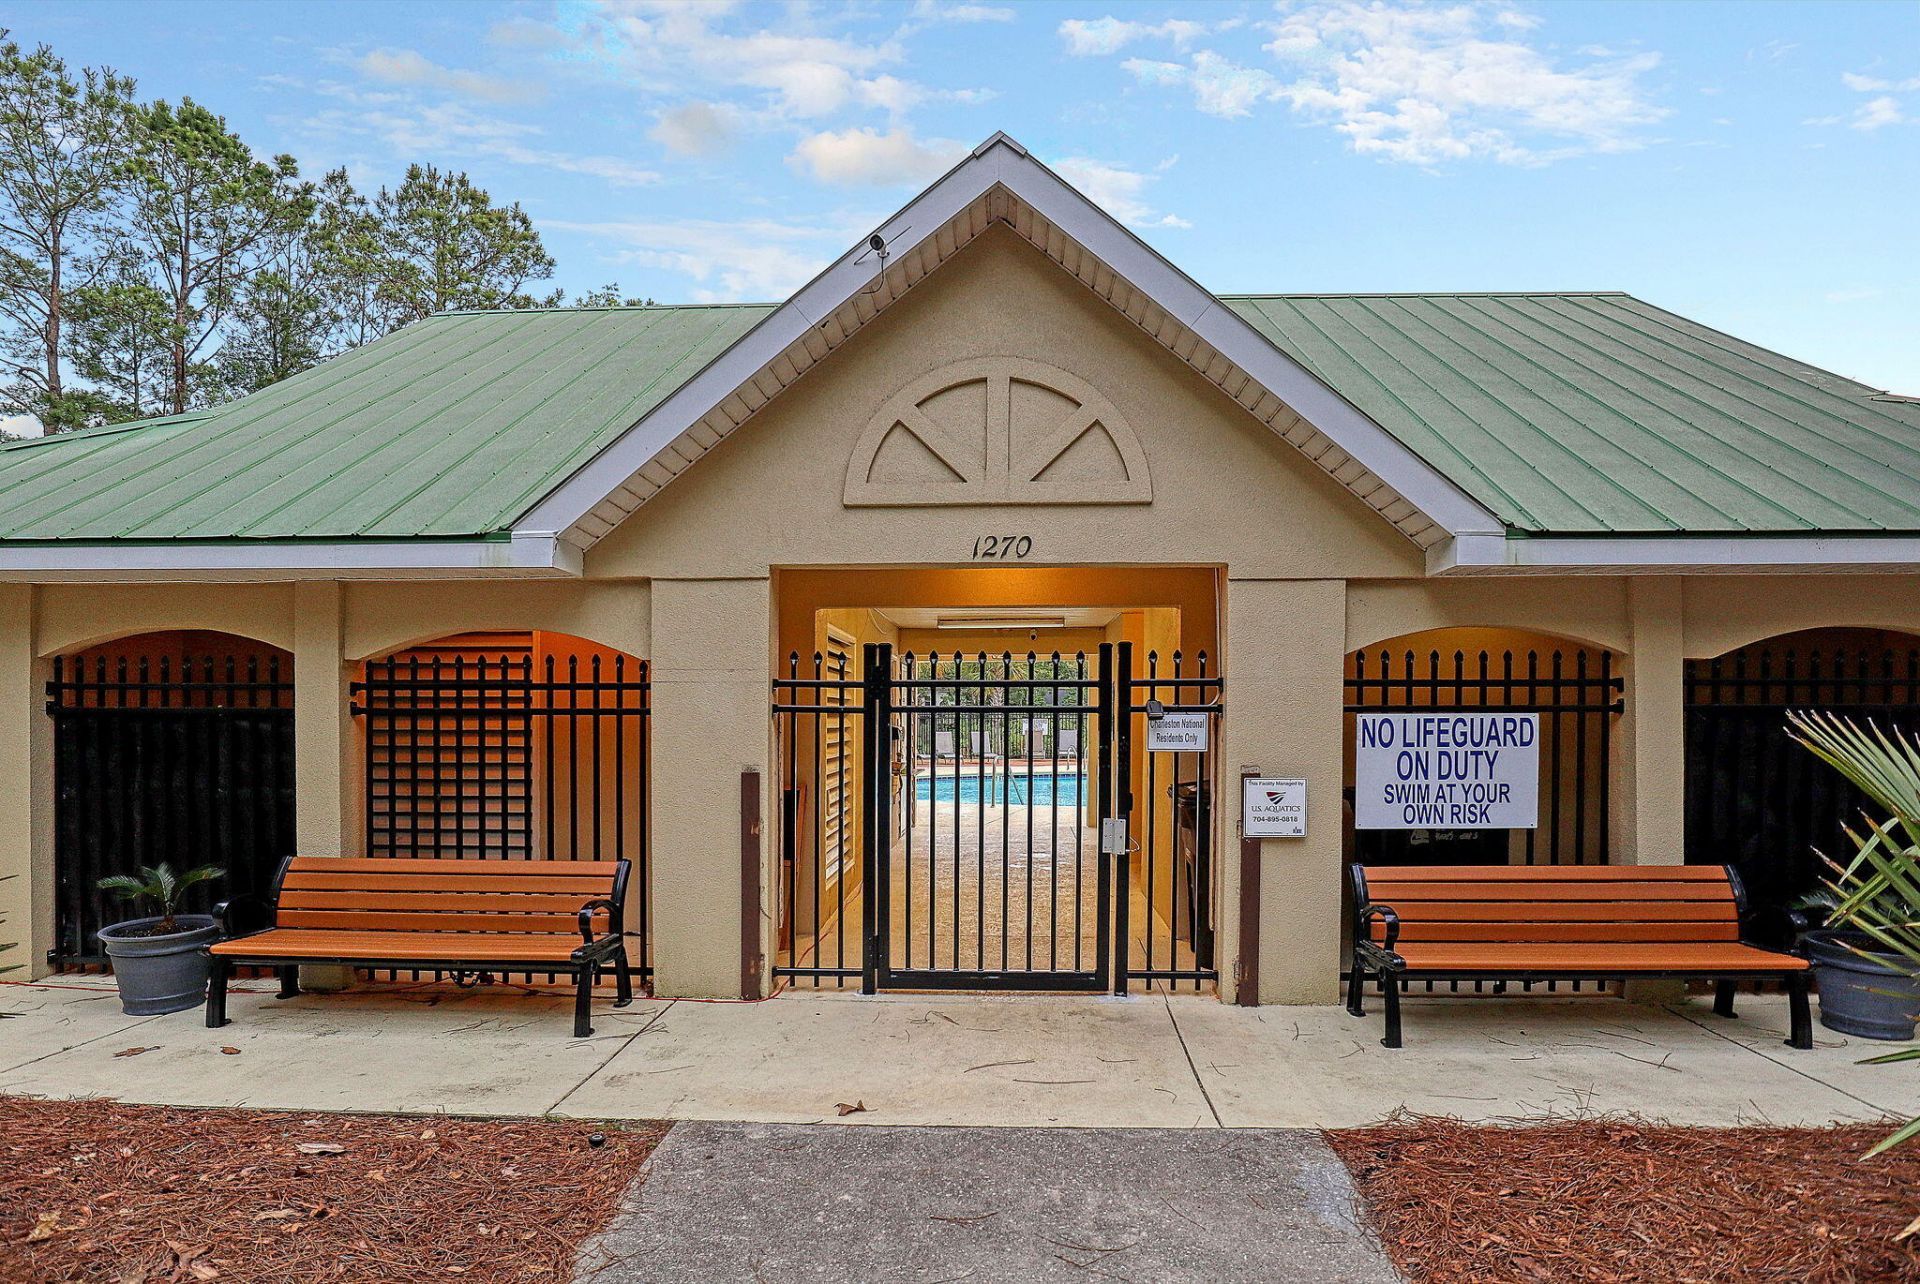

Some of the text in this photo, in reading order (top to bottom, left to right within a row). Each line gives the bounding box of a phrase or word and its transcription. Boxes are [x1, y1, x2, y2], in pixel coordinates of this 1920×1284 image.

[973, 535, 1032, 560] 1270
[1150, 718, 1205, 729] Charleston National
[1361, 717, 1535, 748] NO LIFEGUARD
[1156, 733, 1198, 745] Residents Only
[1396, 750, 1499, 781] ON DUTY
[1384, 783, 1511, 804] SWIM AT YOUR
[1264, 805, 1301, 813] AQUATICS
[1403, 803, 1491, 825] OWN RISK
